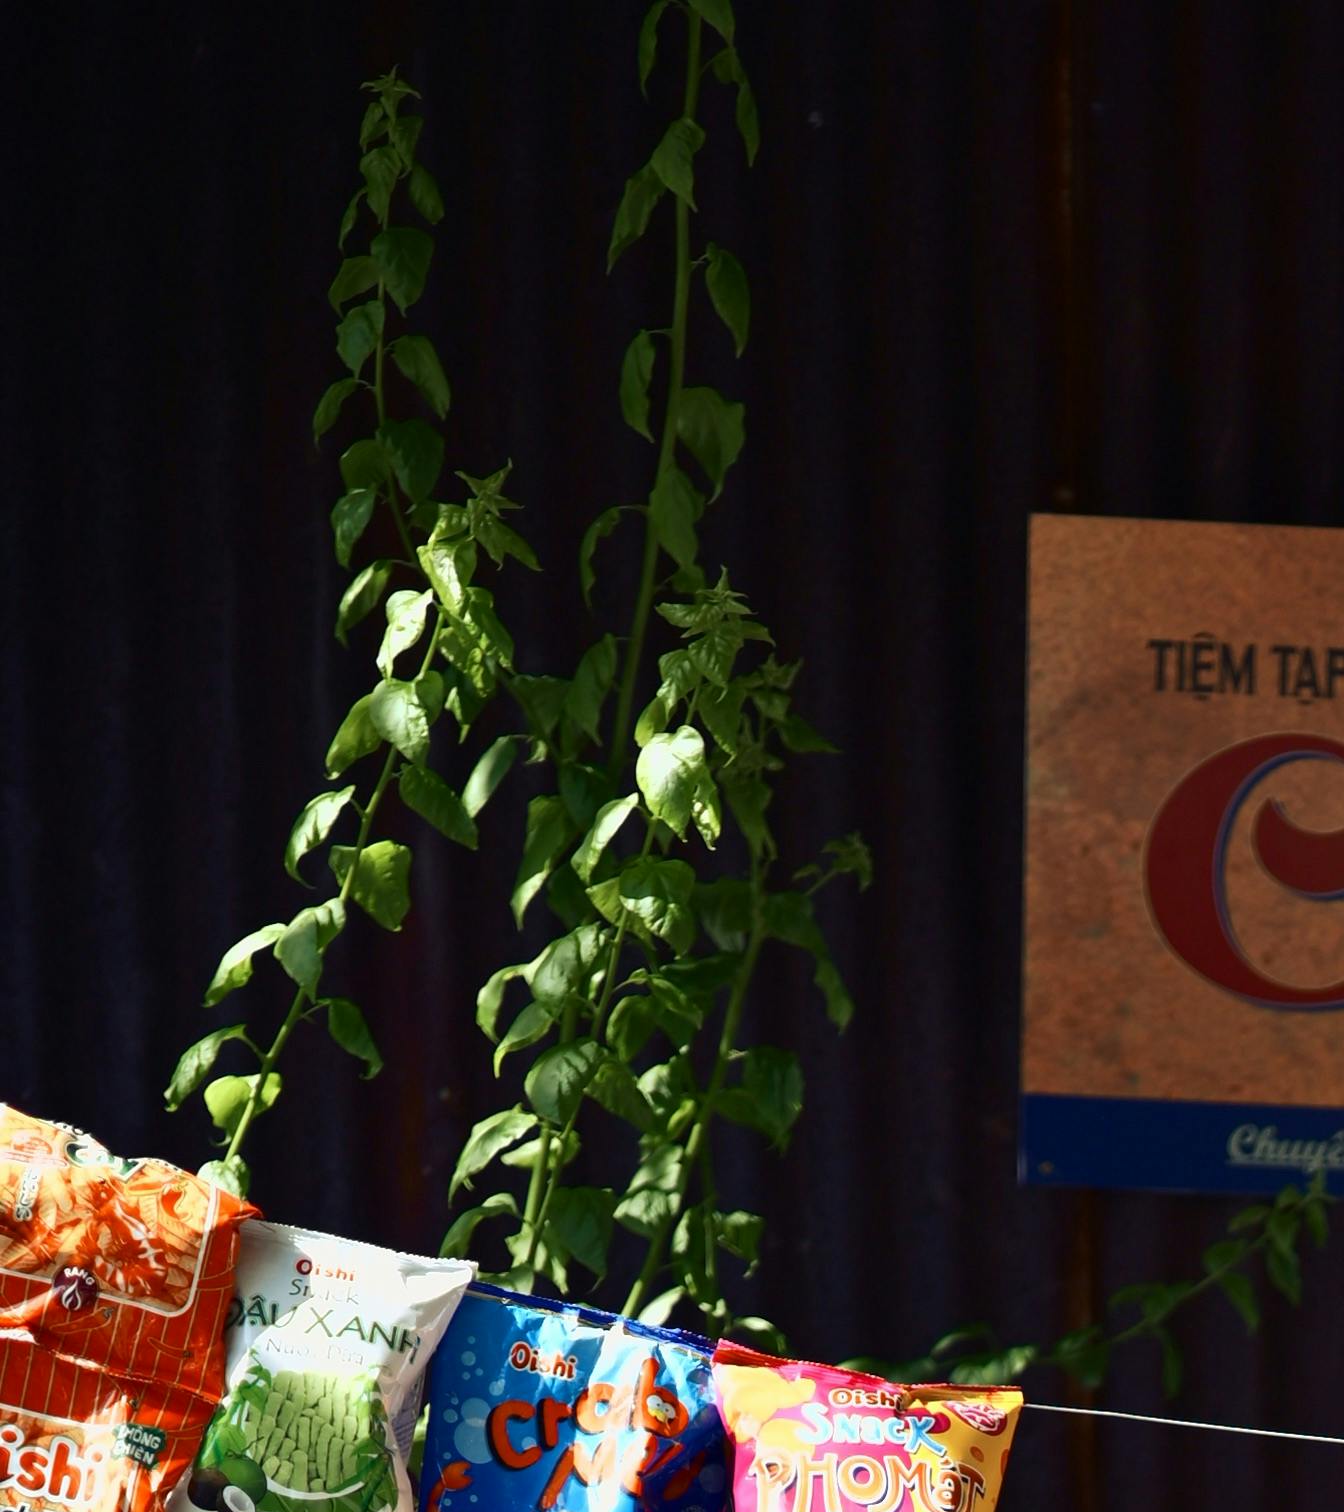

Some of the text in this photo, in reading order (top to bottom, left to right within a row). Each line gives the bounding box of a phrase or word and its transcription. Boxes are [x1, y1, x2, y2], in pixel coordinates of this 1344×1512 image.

[1146, 631, 1257, 701] TIỆM
[295, 1259, 358, 1282] Oishi
[510, 1340, 578, 1380] Oishi
[486, 1357, 690, 1471] Crab
[0, 1422, 105, 1502] ishi
